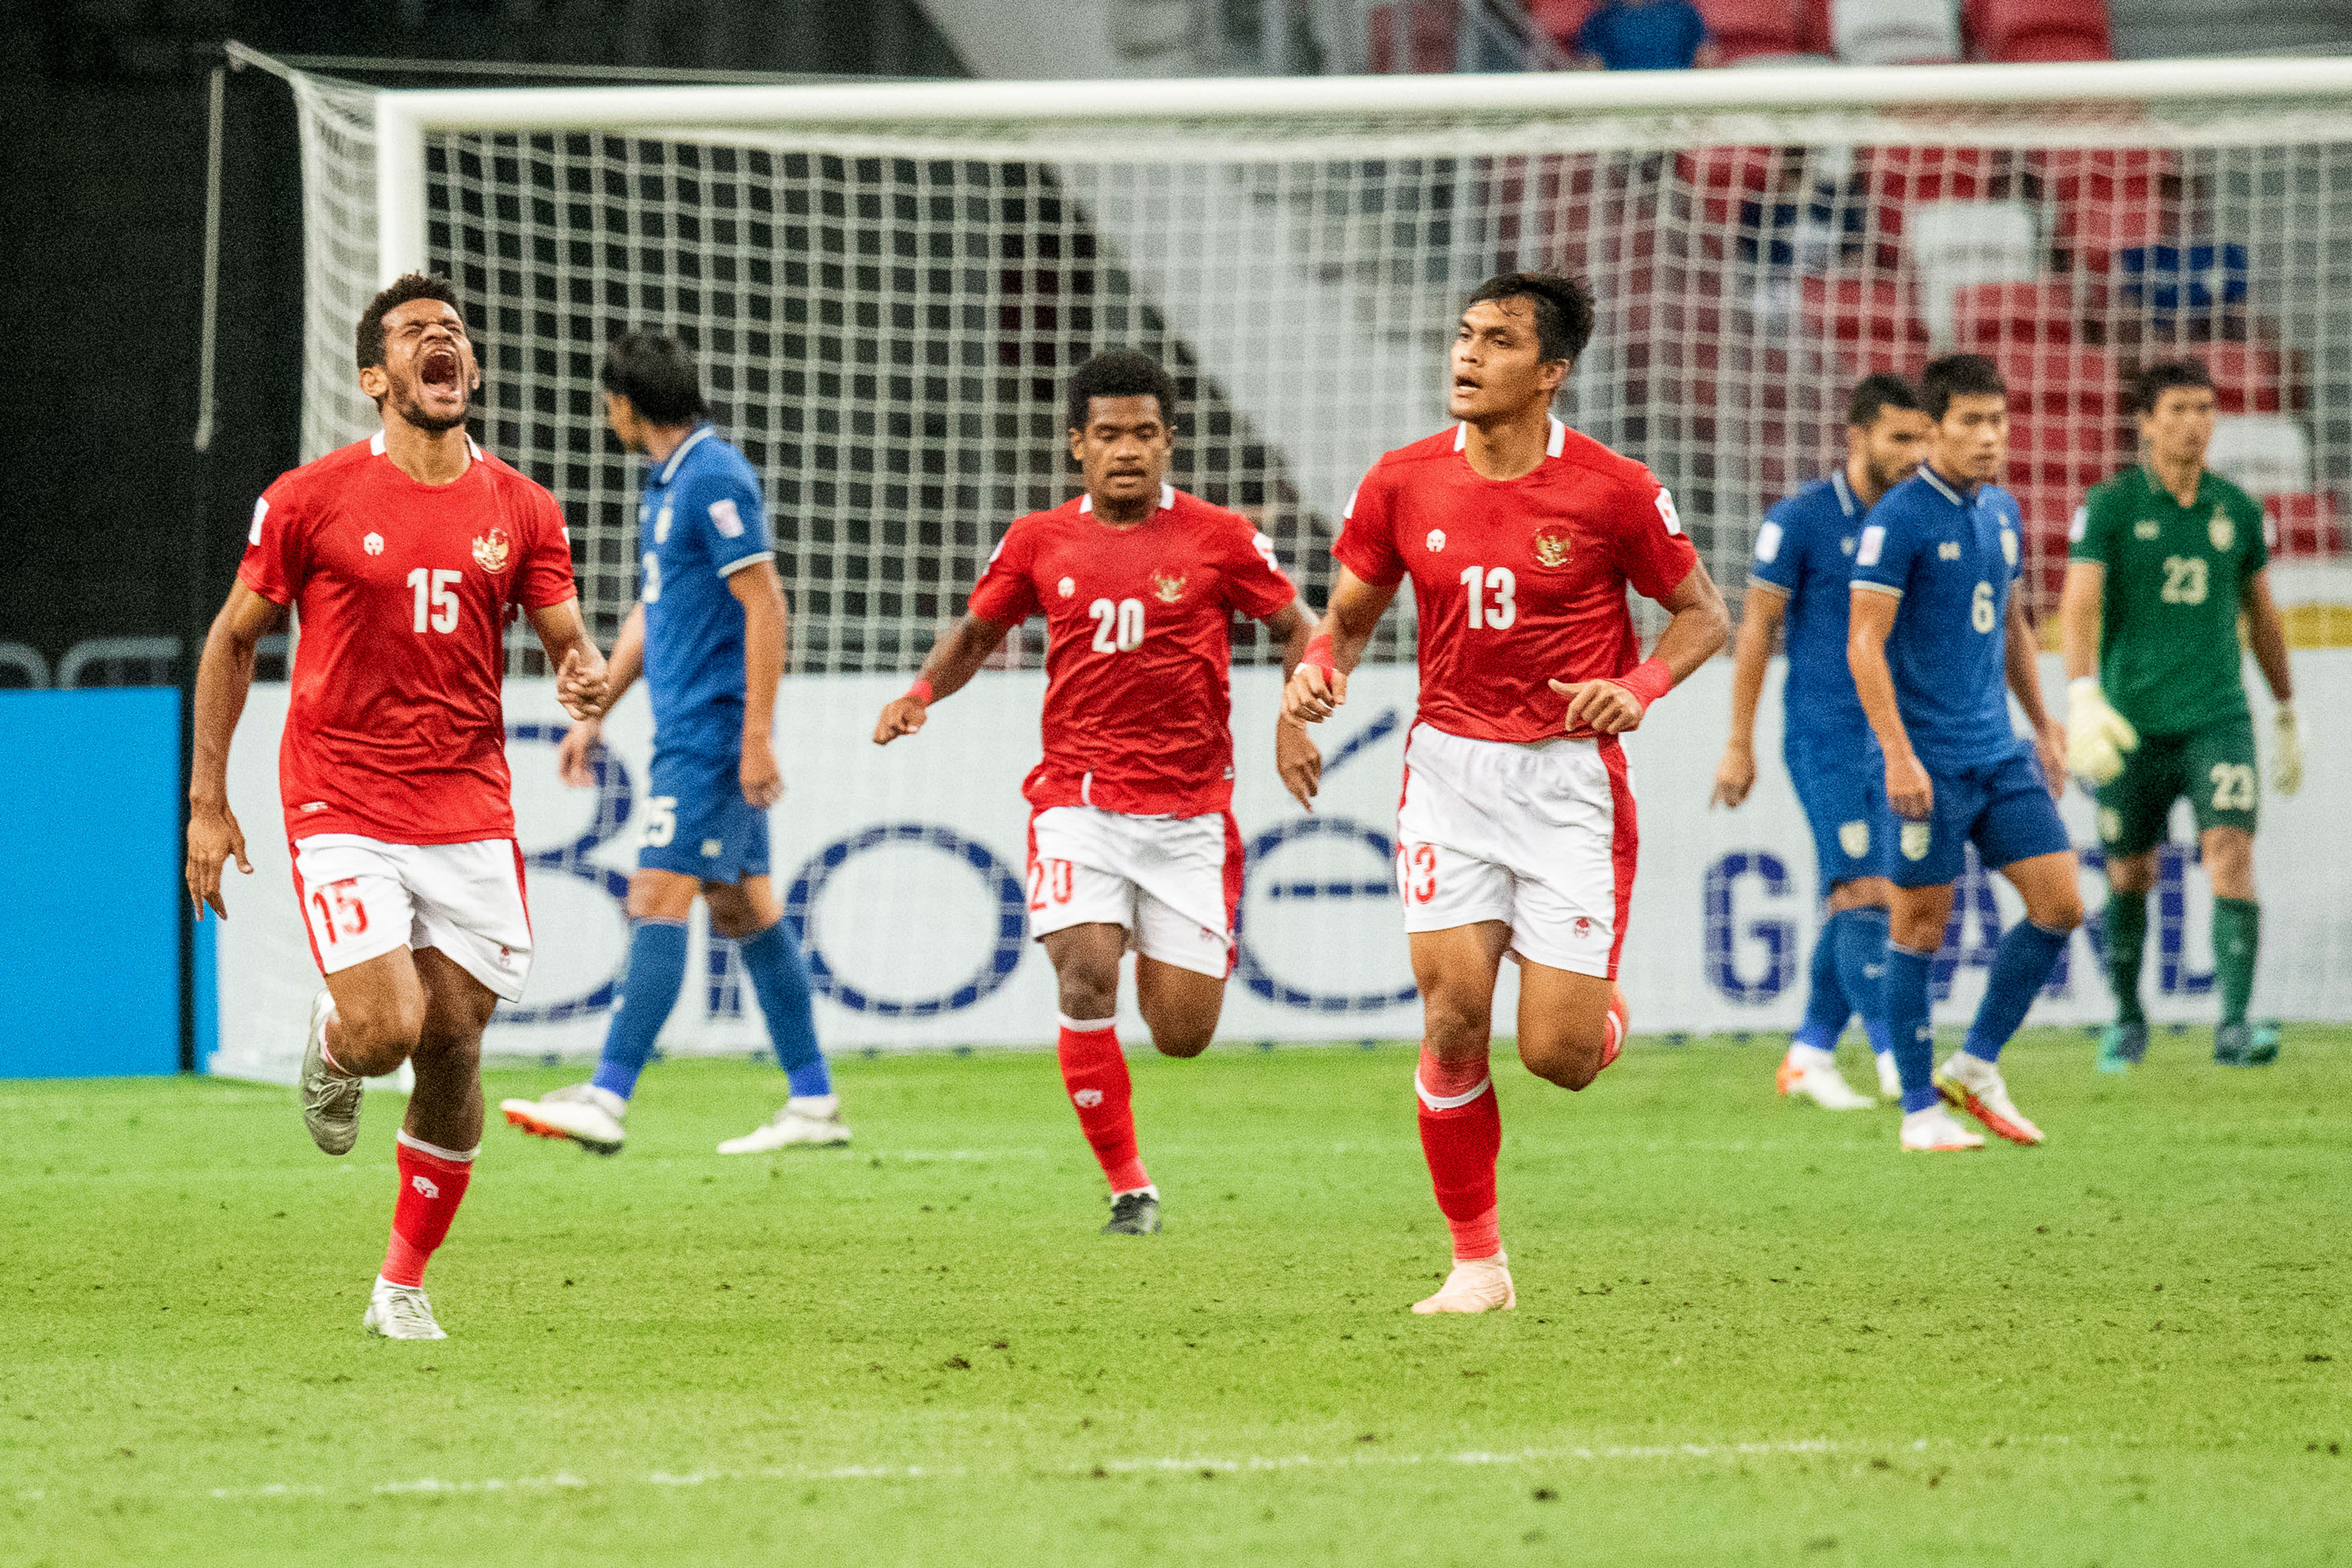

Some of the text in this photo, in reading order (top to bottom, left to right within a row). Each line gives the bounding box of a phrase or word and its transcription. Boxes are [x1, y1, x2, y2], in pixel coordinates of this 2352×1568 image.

[407, 568, 463, 634] 15
[1460, 566, 1516, 630] 13
[1972, 580, 1994, 634] 6
[2162, 556, 2209, 606] 23
[1088, 598, 1145, 654] 20
[2210, 763, 2256, 811] 23
[312, 877, 368, 944] 15
[1028, 859, 1073, 912] 20
